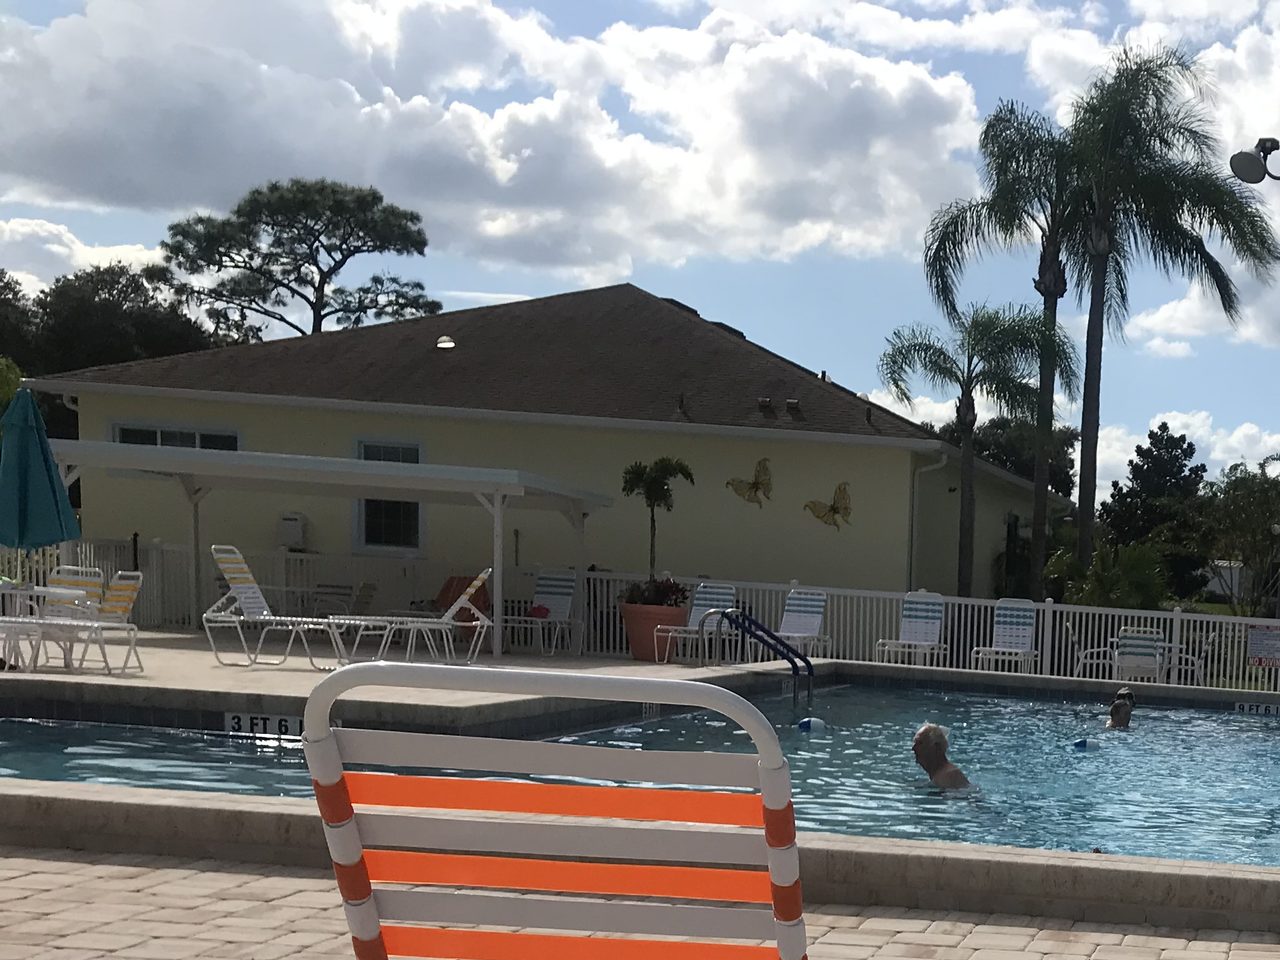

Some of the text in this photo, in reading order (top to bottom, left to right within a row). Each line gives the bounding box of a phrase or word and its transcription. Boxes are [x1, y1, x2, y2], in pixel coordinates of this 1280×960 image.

[1249, 657, 1259, 666] NO
[1249, 703, 1260, 713] FT
[1265, 705, 1271, 715] 6
[231, 715, 242, 732] 3
[249, 716, 270, 733] FT
[277, 718, 289, 735] 6
